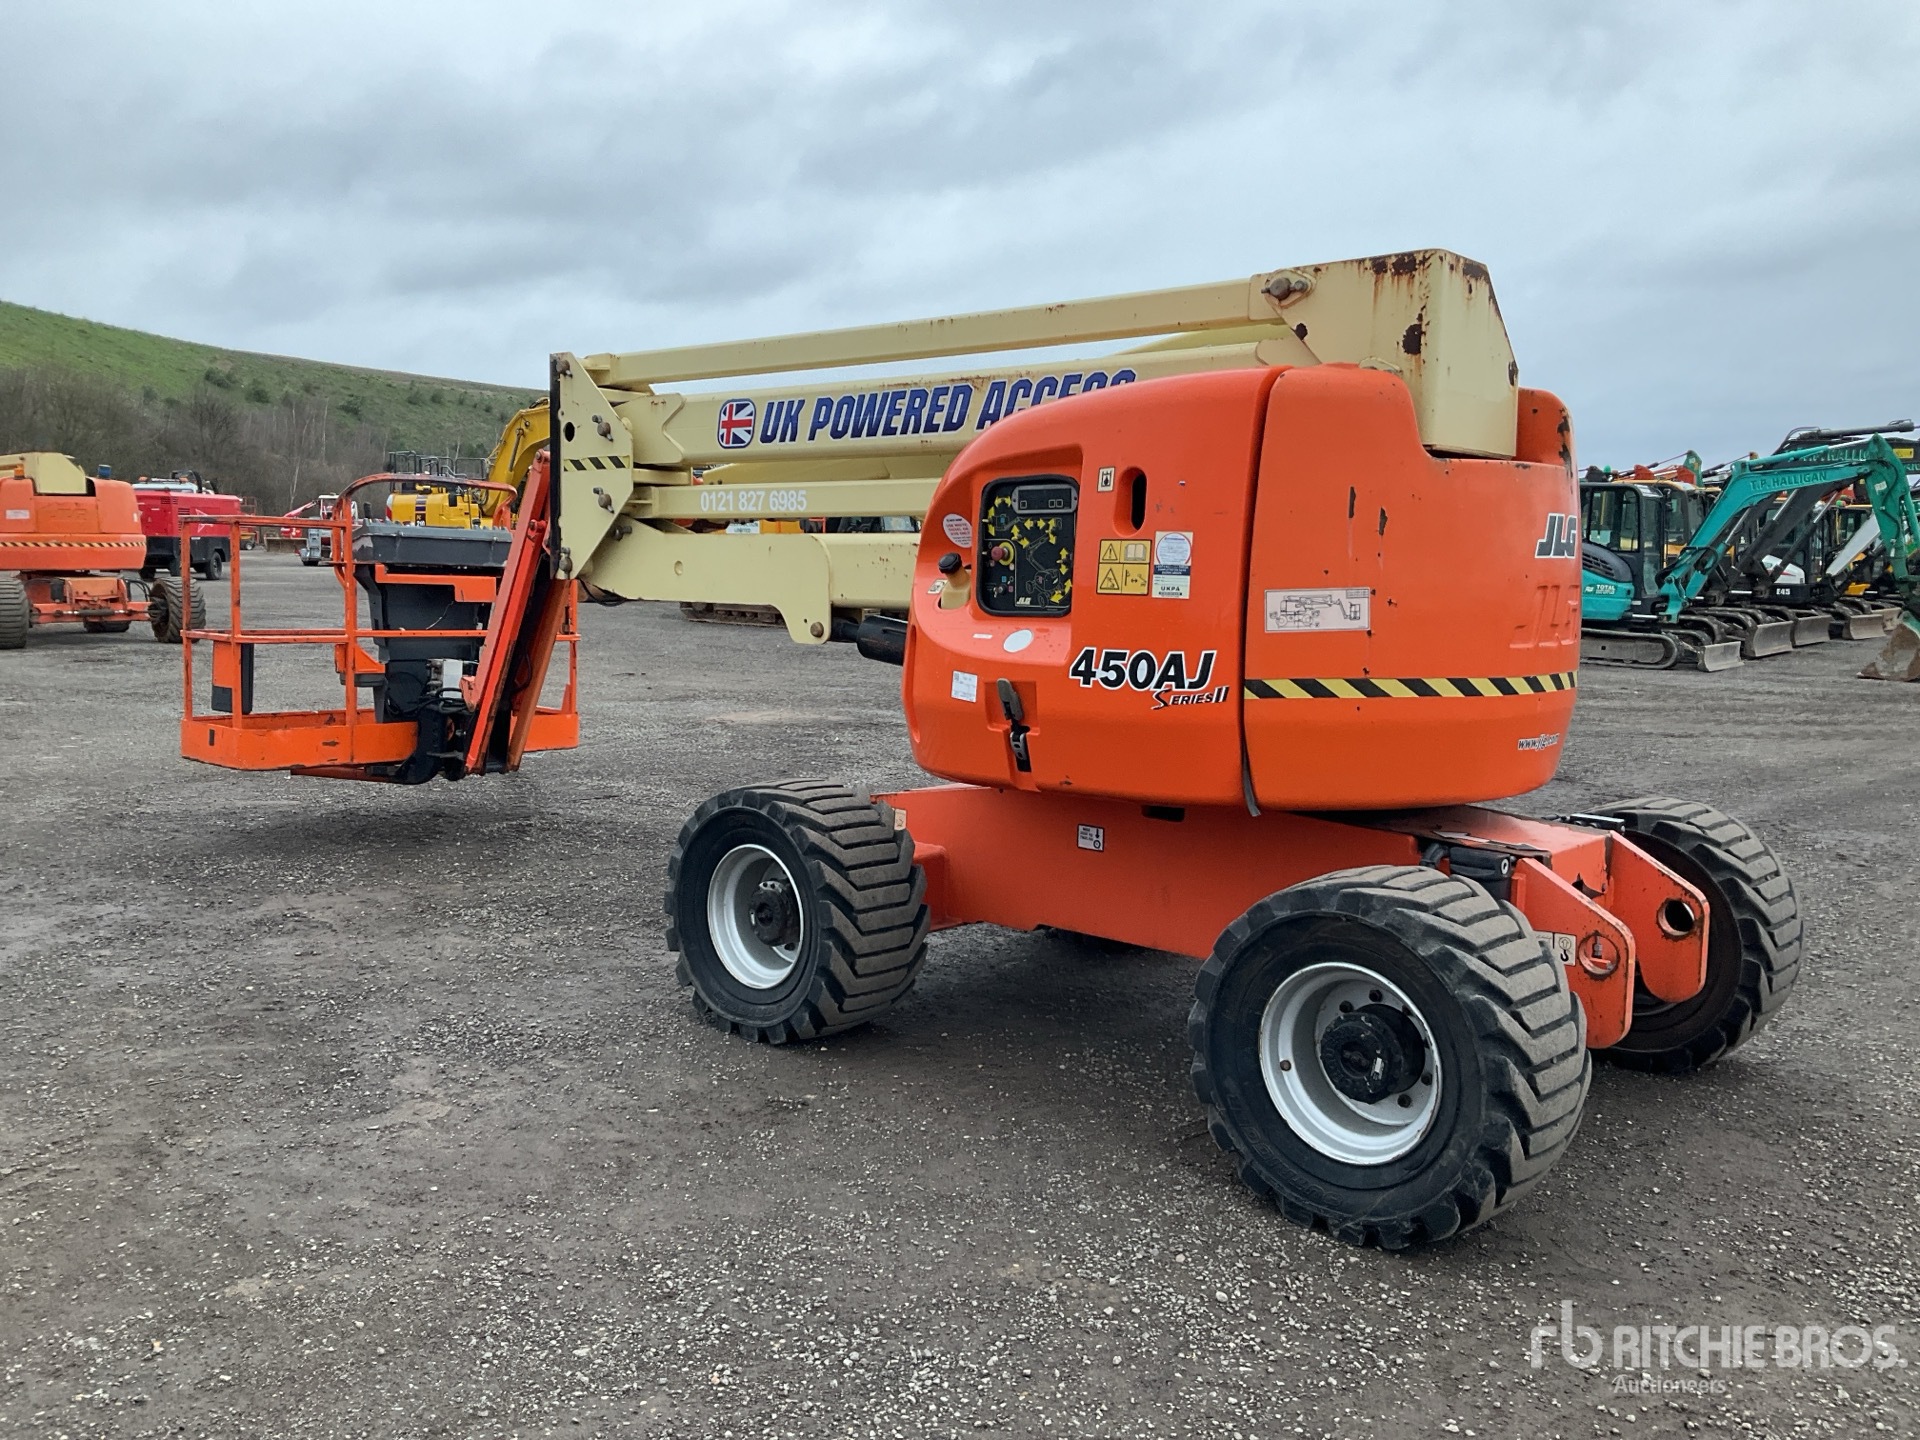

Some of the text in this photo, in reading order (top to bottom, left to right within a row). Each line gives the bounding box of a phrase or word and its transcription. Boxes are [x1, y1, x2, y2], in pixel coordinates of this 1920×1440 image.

[759, 399, 805, 444] UK
[808, 384, 974, 441] POWERED
[1772, 472, 1827, 489] HALLIGAN
[700, 490, 807, 511] 0121 827 6985
[1535, 513, 1577, 558] JLG
[1016, 597, 1031, 605] JLG
[1069, 647, 1217, 691] 450AJ
